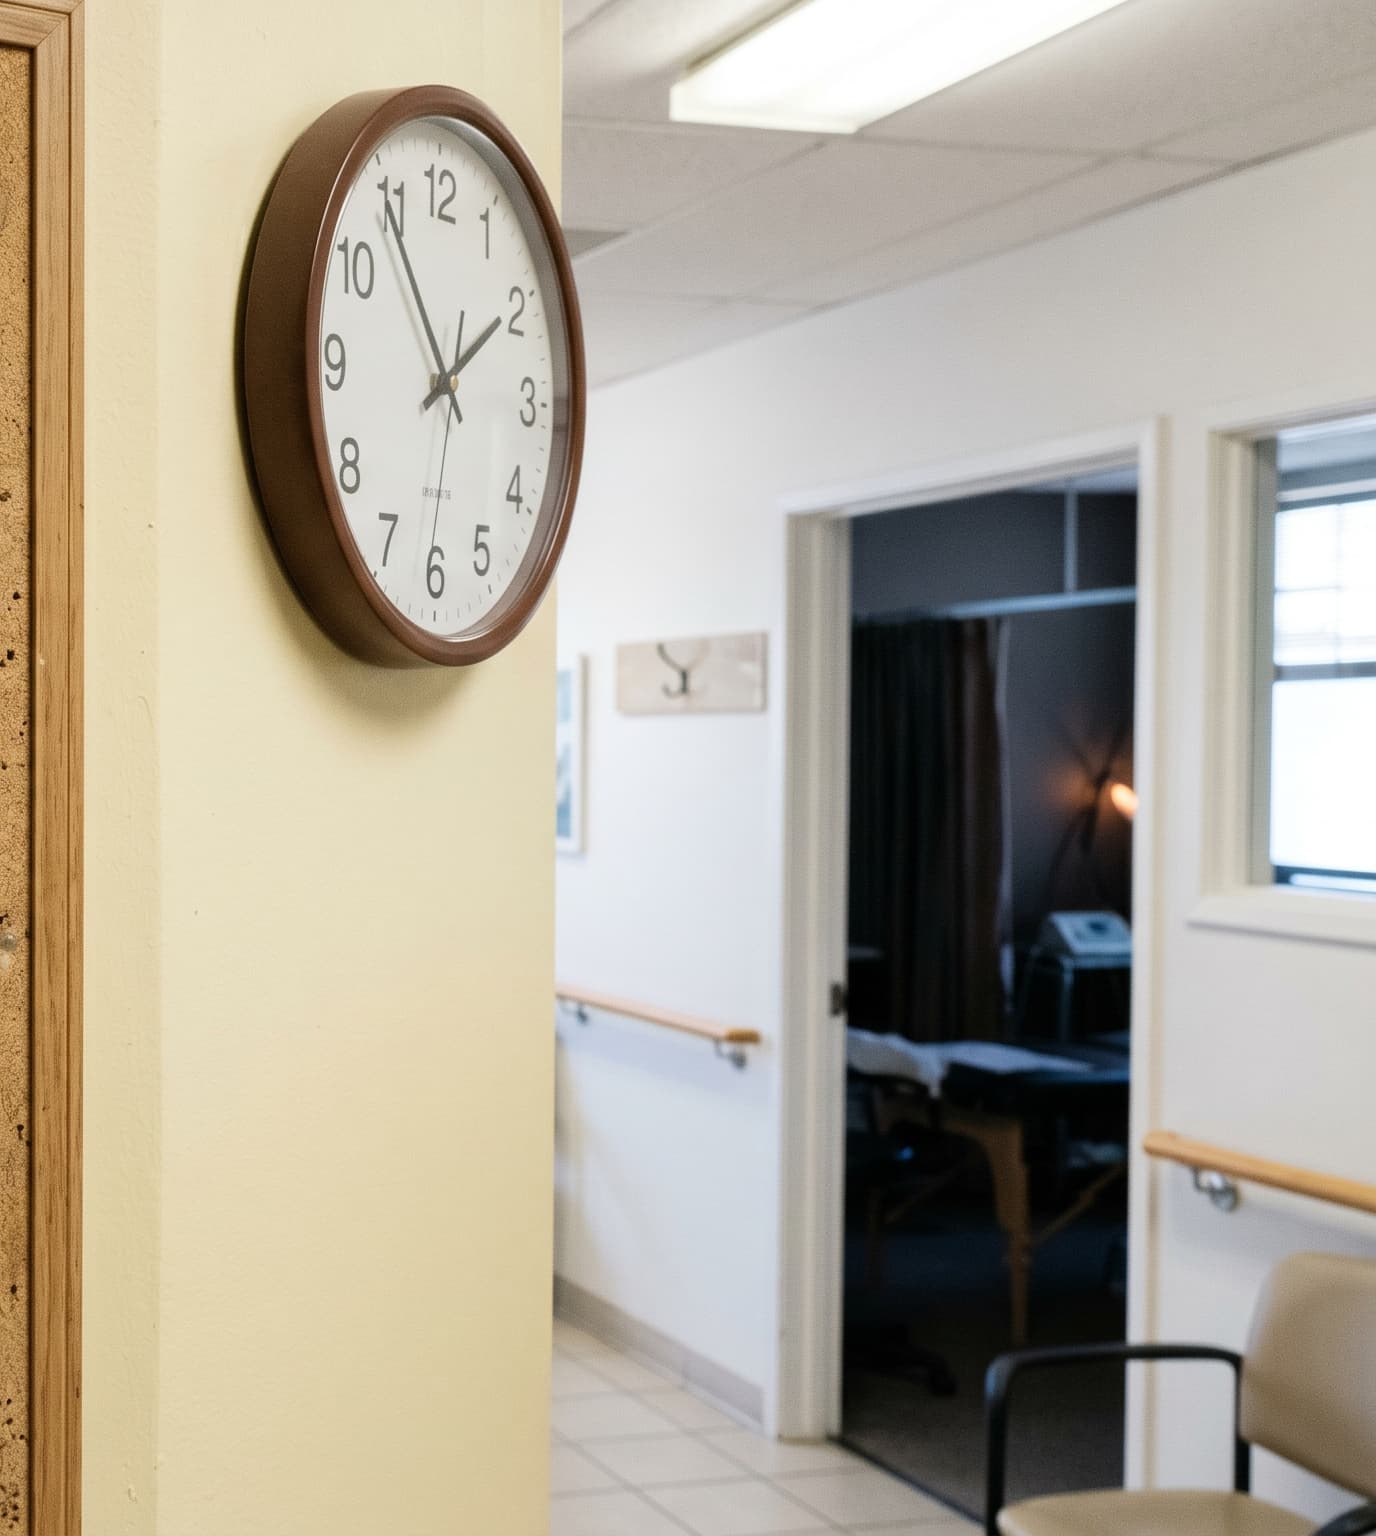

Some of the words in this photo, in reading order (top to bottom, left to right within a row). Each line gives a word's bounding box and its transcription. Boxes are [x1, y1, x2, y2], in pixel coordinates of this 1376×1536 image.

[377, 175, 405, 238] 11
[424, 163, 456, 225] 12
[479, 207, 489, 260] 1
[337, 235, 374, 300] 10
[508, 286, 525, 337] 2
[324, 333, 346, 391] 9
[520, 376, 536, 427] 3
[339, 437, 360, 494] 8
[506, 465, 523, 514] 4
[379, 512, 398, 567] 7
[473, 524, 490, 577] 5
[426, 545, 445, 599] 6
